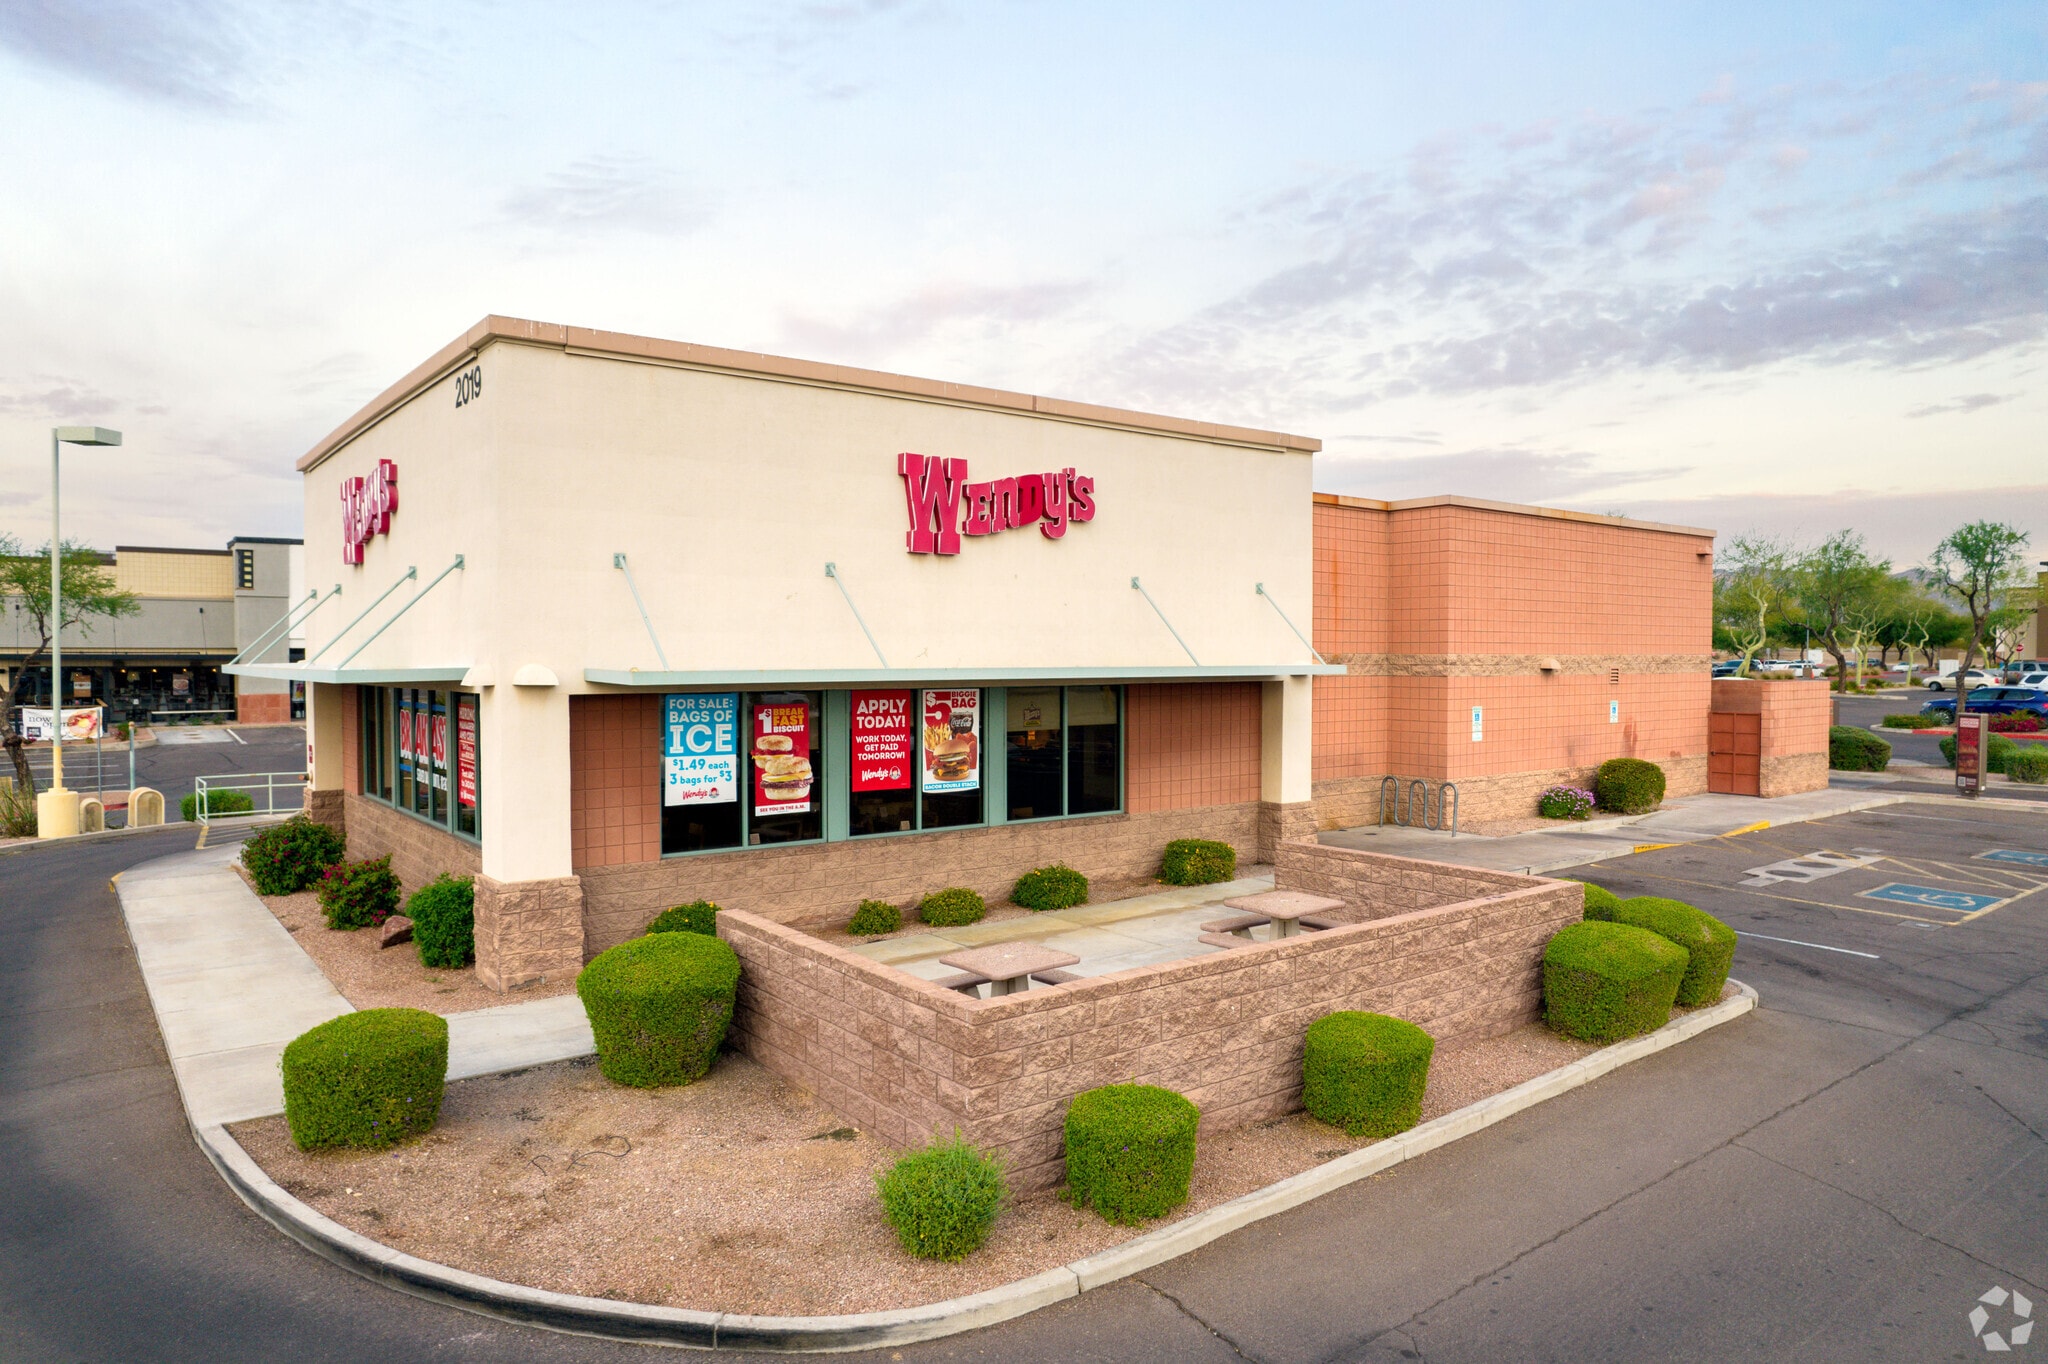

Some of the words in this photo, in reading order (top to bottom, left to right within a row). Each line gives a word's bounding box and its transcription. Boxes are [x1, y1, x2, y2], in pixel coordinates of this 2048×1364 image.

[455, 365, 482, 408] 2019
[669, 698, 696, 709] FOR
[698, 698, 733, 709] SALE:
[856, 699, 907, 714] APPLY
[951, 698, 977, 708] BAG
[669, 711, 710, 723] BAGS
[713, 710, 733, 722] OF
[773, 707, 804, 716] BREAK
[773, 715, 804, 726] FAST
[856, 715, 906, 729] TODAY!
[773, 724, 805, 733] BISCUIT
[669, 724, 733, 754] ICE
[855, 735, 880, 743] WORK
[880, 734, 907, 742] TODAY,
[864, 744, 879, 752] GET
[880, 743, 899, 751] PAID
[857, 752, 905, 761] TOMORROW!
[672, 758, 706, 771] $1.49
[708, 761, 730, 769] each
[669, 773, 678, 785] 3
[680, 775, 702, 786] bags
[703, 774, 718, 783] for
[719, 770, 732, 782] $3
[861, 767, 889, 782] Wendy's
[682, 788, 708, 800] Wendy's
